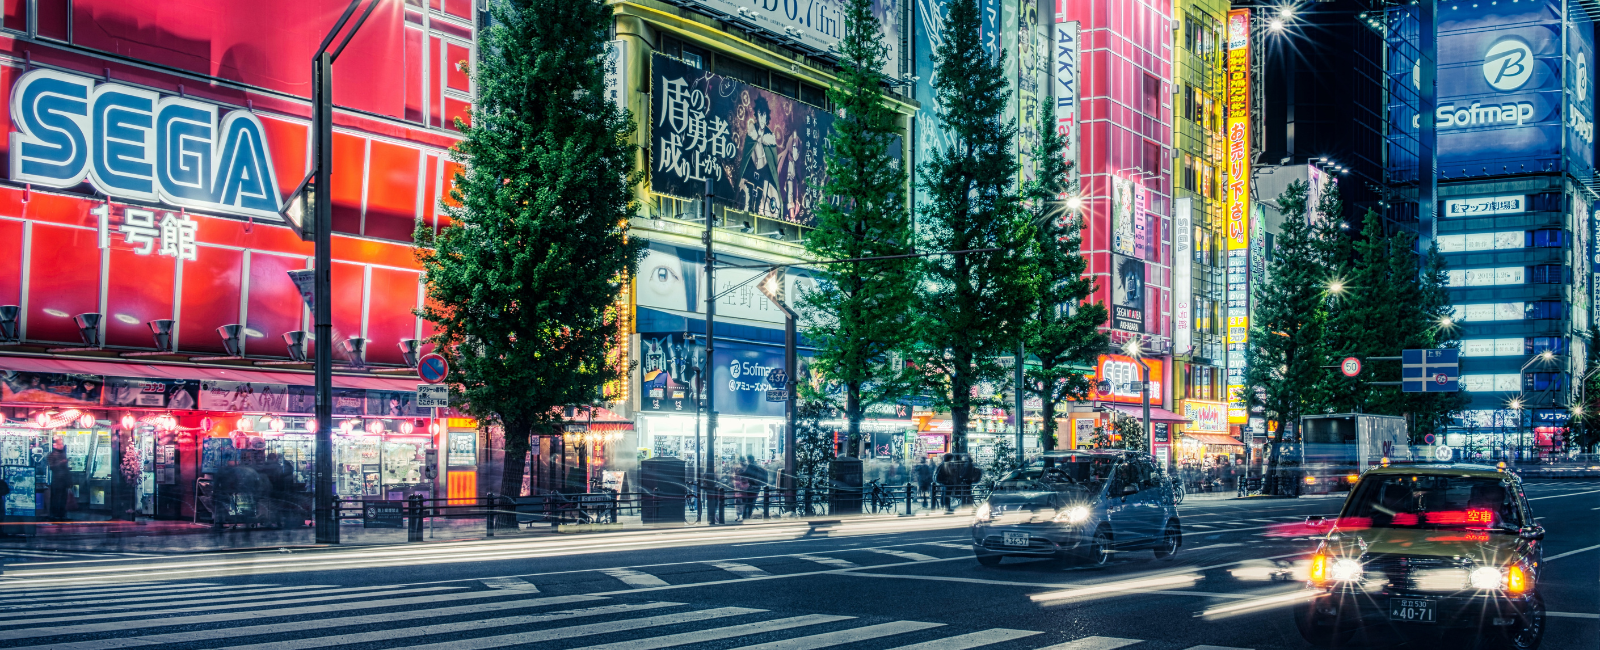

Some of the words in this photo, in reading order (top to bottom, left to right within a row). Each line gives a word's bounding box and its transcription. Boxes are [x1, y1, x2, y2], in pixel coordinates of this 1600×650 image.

[1058, 28, 1073, 93] AKKY
[1230, 49, 1246, 57] DVD
[1232, 72, 1244, 80] CD
[659, 75, 737, 158] 盾の勇者の
[1437, 102, 1534, 127] Sofmap
[10, 69, 282, 221] SEGA
[658, 132, 722, 183] 成り上がり
[90, 204, 198, 261] 1号館
[1177, 217, 1189, 252] SEGA
[742, 361, 776, 377] Sofma
[1345, 362, 1358, 371] 50
[768, 373, 786, 383] 437
[1103, 360, 1141, 397] SEGA
[1467, 509, 1493, 522] 空車
[1400, 607, 1432, 621] 40-71
[1414, 600, 1427, 608] 530
